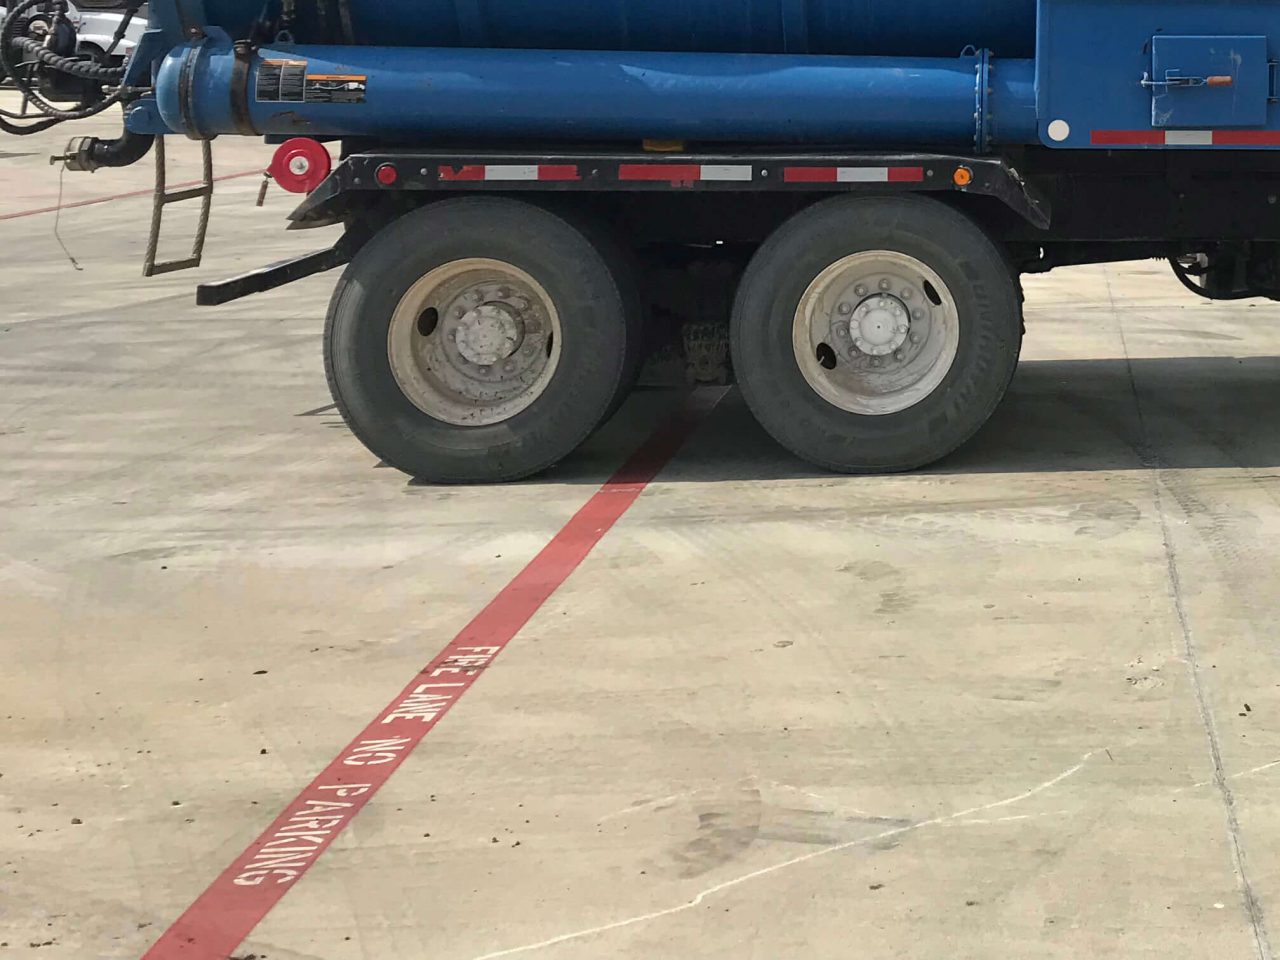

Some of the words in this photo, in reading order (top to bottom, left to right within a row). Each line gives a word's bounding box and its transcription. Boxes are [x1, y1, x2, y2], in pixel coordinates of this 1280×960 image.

[429, 645, 500, 677] FIRE
[381, 682, 465, 724] LANE
[343, 737, 411, 766] NO
[233, 783, 372, 886] PARKING
